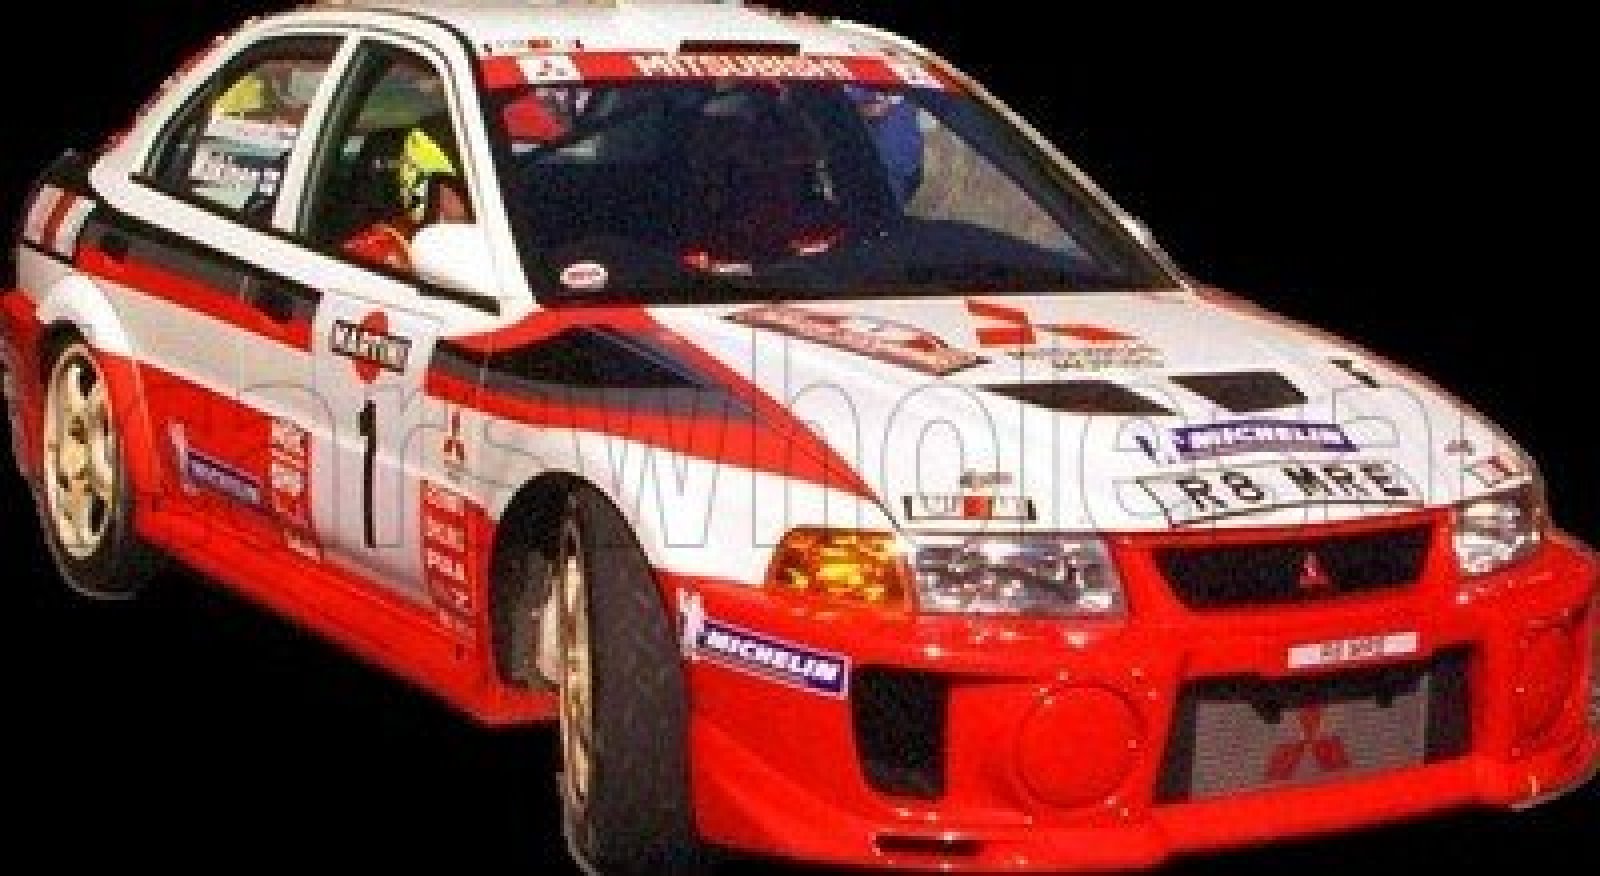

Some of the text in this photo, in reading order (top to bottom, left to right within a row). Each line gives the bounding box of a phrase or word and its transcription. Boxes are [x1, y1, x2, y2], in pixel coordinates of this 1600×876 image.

[1189, 426, 1345, 448] MICHELIN
[357, 399, 377, 549] 1
[1175, 464, 1409, 512] R8 MRE
[706, 631, 837, 681] MICHELIN
